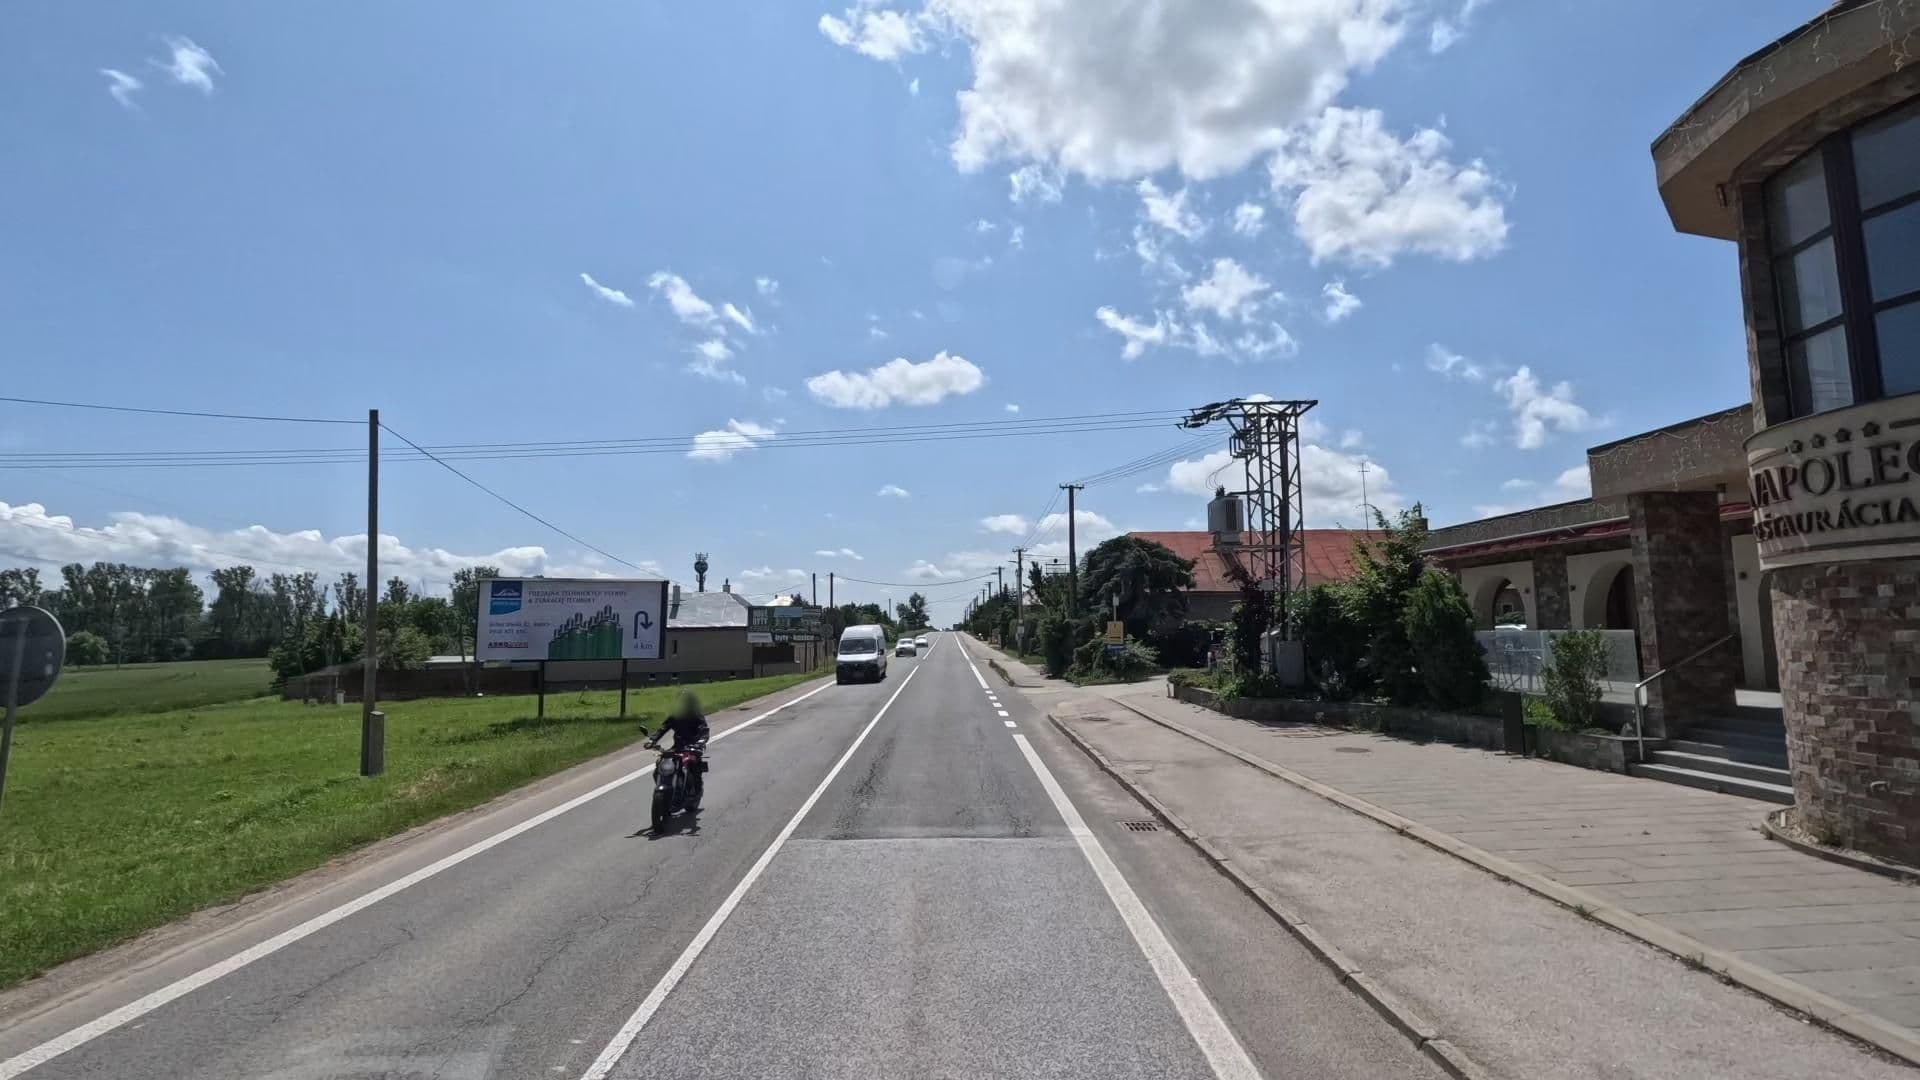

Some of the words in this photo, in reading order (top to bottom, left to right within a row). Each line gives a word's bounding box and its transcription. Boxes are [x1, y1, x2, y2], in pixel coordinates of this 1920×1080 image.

[1750, 439, 1920, 508] APOLE
[1753, 496, 1920, 542] ŠTAURÁCIA
[640, 641, 653, 649] km
